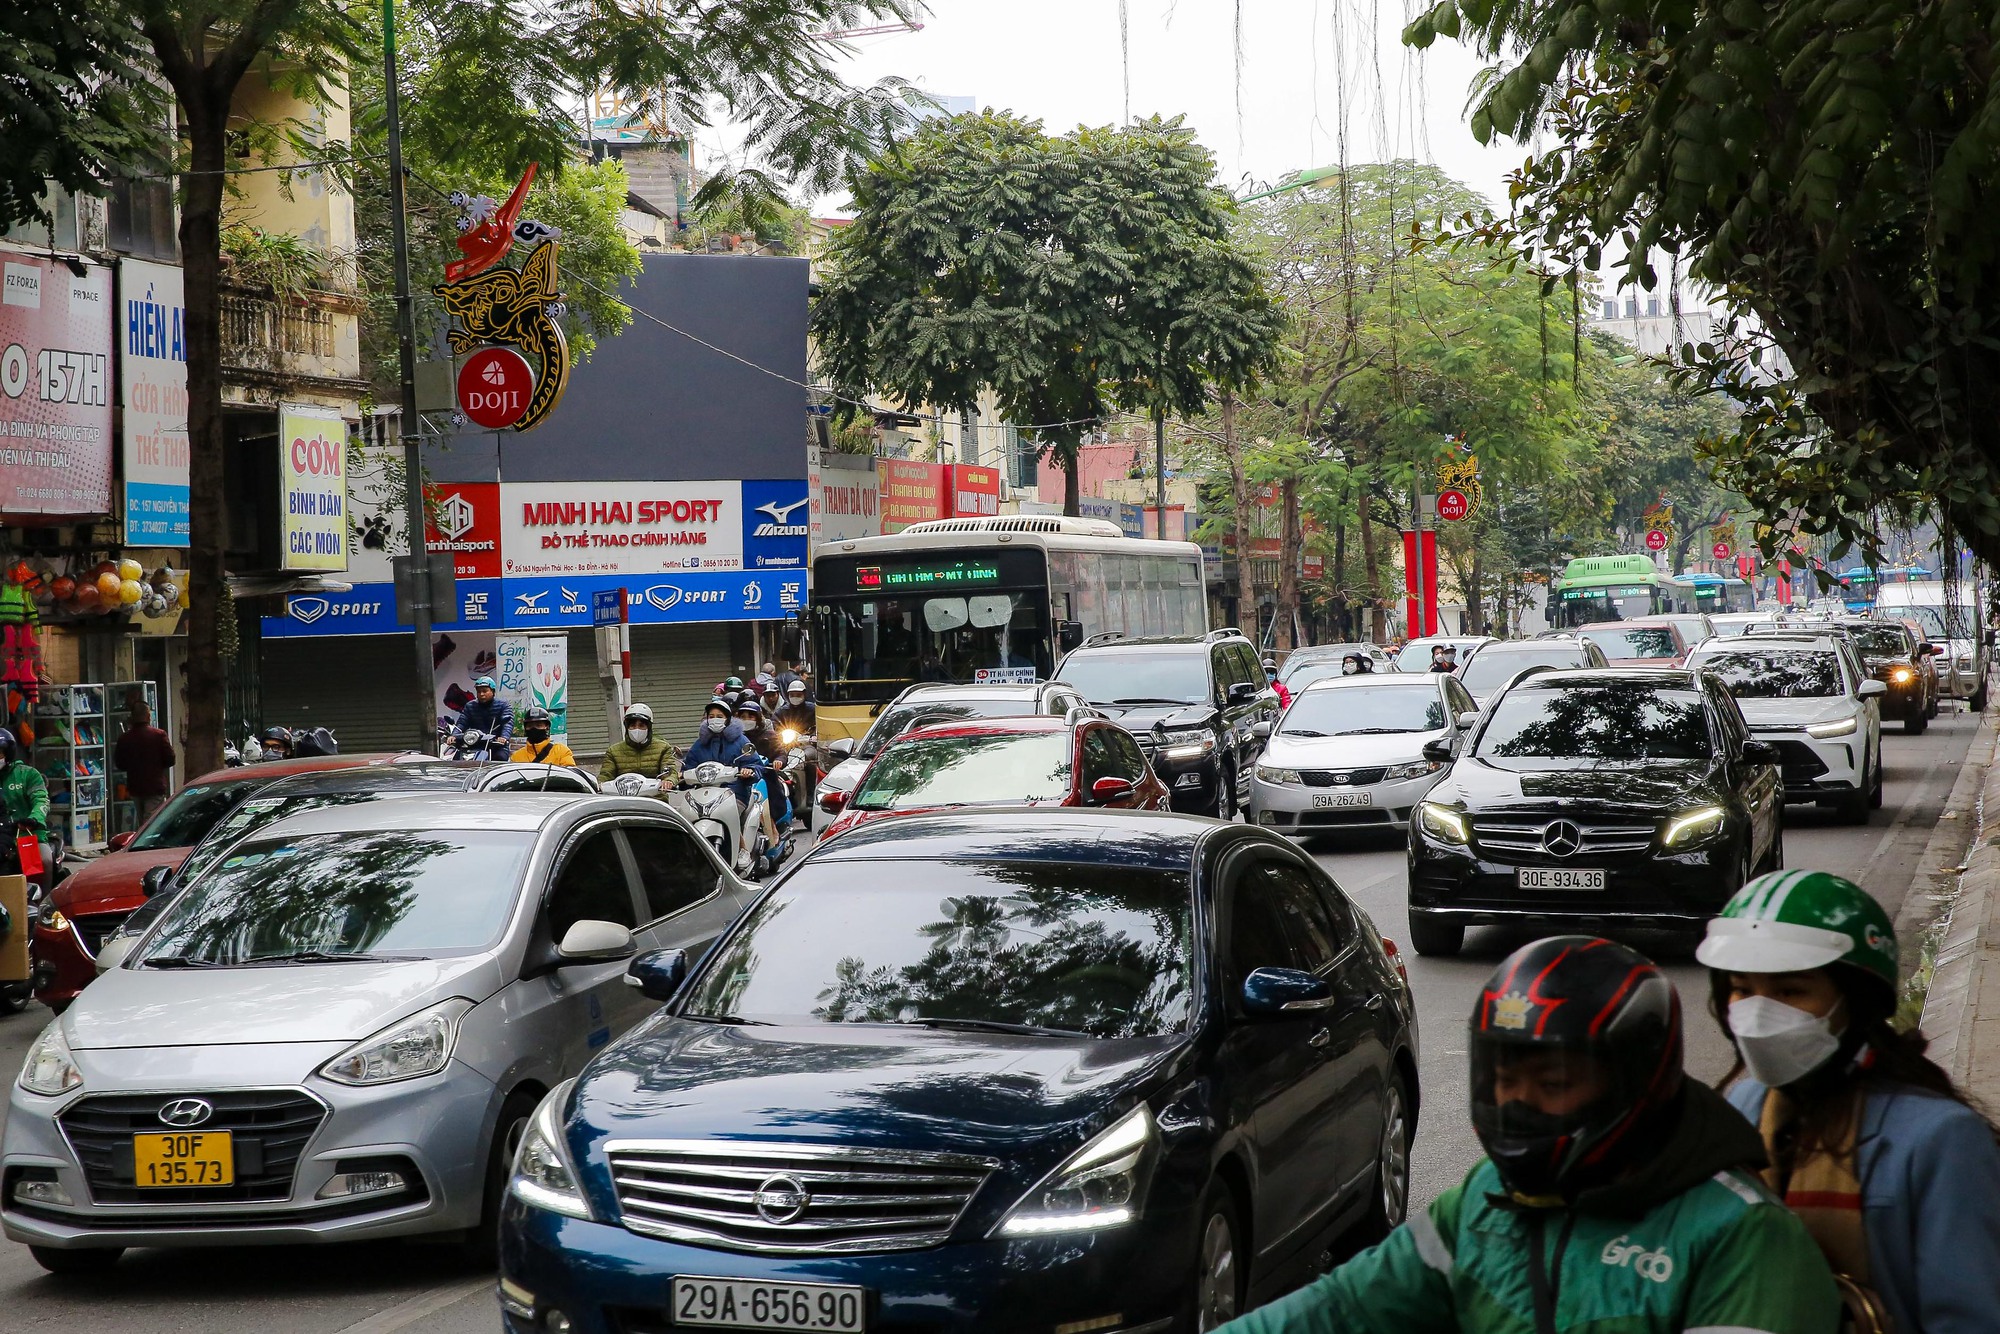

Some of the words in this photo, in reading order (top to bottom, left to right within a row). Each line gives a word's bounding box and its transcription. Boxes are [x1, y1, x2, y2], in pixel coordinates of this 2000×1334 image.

[6, 274, 16, 286] FZ
[16, 275, 38, 290] FORZA
[128, 282, 166, 360] HIỀN
[36, 347, 106, 406] 157H
[468, 390, 521, 416] DOJI
[10, 419, 34, 438] ĐÌNH
[35, 421, 48, 439] VÀ
[49, 422, 81, 441] PHÒNG
[82, 425, 100, 446] TẬP
[20, 447, 34, 466] VÀ
[35, 451, 50, 467] THI
[51, 446, 71, 468] ĐẤU
[291, 433, 342, 477] CƠM
[823, 485, 849, 515] TRANH
[850, 481, 861, 516] ĐÁ
[862, 483, 877, 519] QUÝ
[890, 483, 913, 497] TRANH
[913, 482, 923, 498] ĐÁ
[923, 484, 937, 499] QUÝ
[141, 500, 152, 513] 157
[289, 487, 316, 515] BÌNH
[319, 489, 342, 517] DÂN
[890, 501, 900, 517] ĐÁ
[900, 504, 921, 518] PHONG
[957, 490, 978, 514] KHUNG
[978, 493, 998, 515] TRANH
[1442, 506, 1463, 516] DOJI
[523, 502, 587, 526] MINH
[590, 501, 633, 525] HAI
[637, 499, 724, 524] SPORT
[290, 527, 312, 554] CÁC
[315, 528, 340, 555] MÓN
[541, 531, 562, 549] ĐỒ
[562, 530, 590, 549] THỂ
[590, 534, 630, 548] THAO
[630, 531, 669, 547] CHÍNH
[457, 566, 466, 574] 20
[466, 566, 476, 574] 30
[522, 564, 531, 572] 163
[531, 563, 550, 574] Nguyễn
[578, 563, 585, 571] Ba
[662, 560, 682, 569] Hotline
[703, 559, 717, 568] 0856
[716, 559, 723, 567] 10
[723, 559, 731, 567] 20
[731, 558, 739, 567] 30
[684, 590, 727, 603] SPORT
[331, 602, 381, 616] SPORT
[560, 604, 588, 613] KAMITO
[498, 639, 526, 656] Cấm
[989, 670, 997, 678] TT
[1015, 668, 1035, 677] CHÍNH
[1314, 793, 1370, 808] 29A-262.49
[1520, 869, 1604, 889] 30E-934.36
[161, 1135, 204, 1159] 30F
[147, 1160, 223, 1184] 135.73
[1600, 1235, 1674, 1283] Grab
[679, 1283, 858, 1329] 29A-656.90
